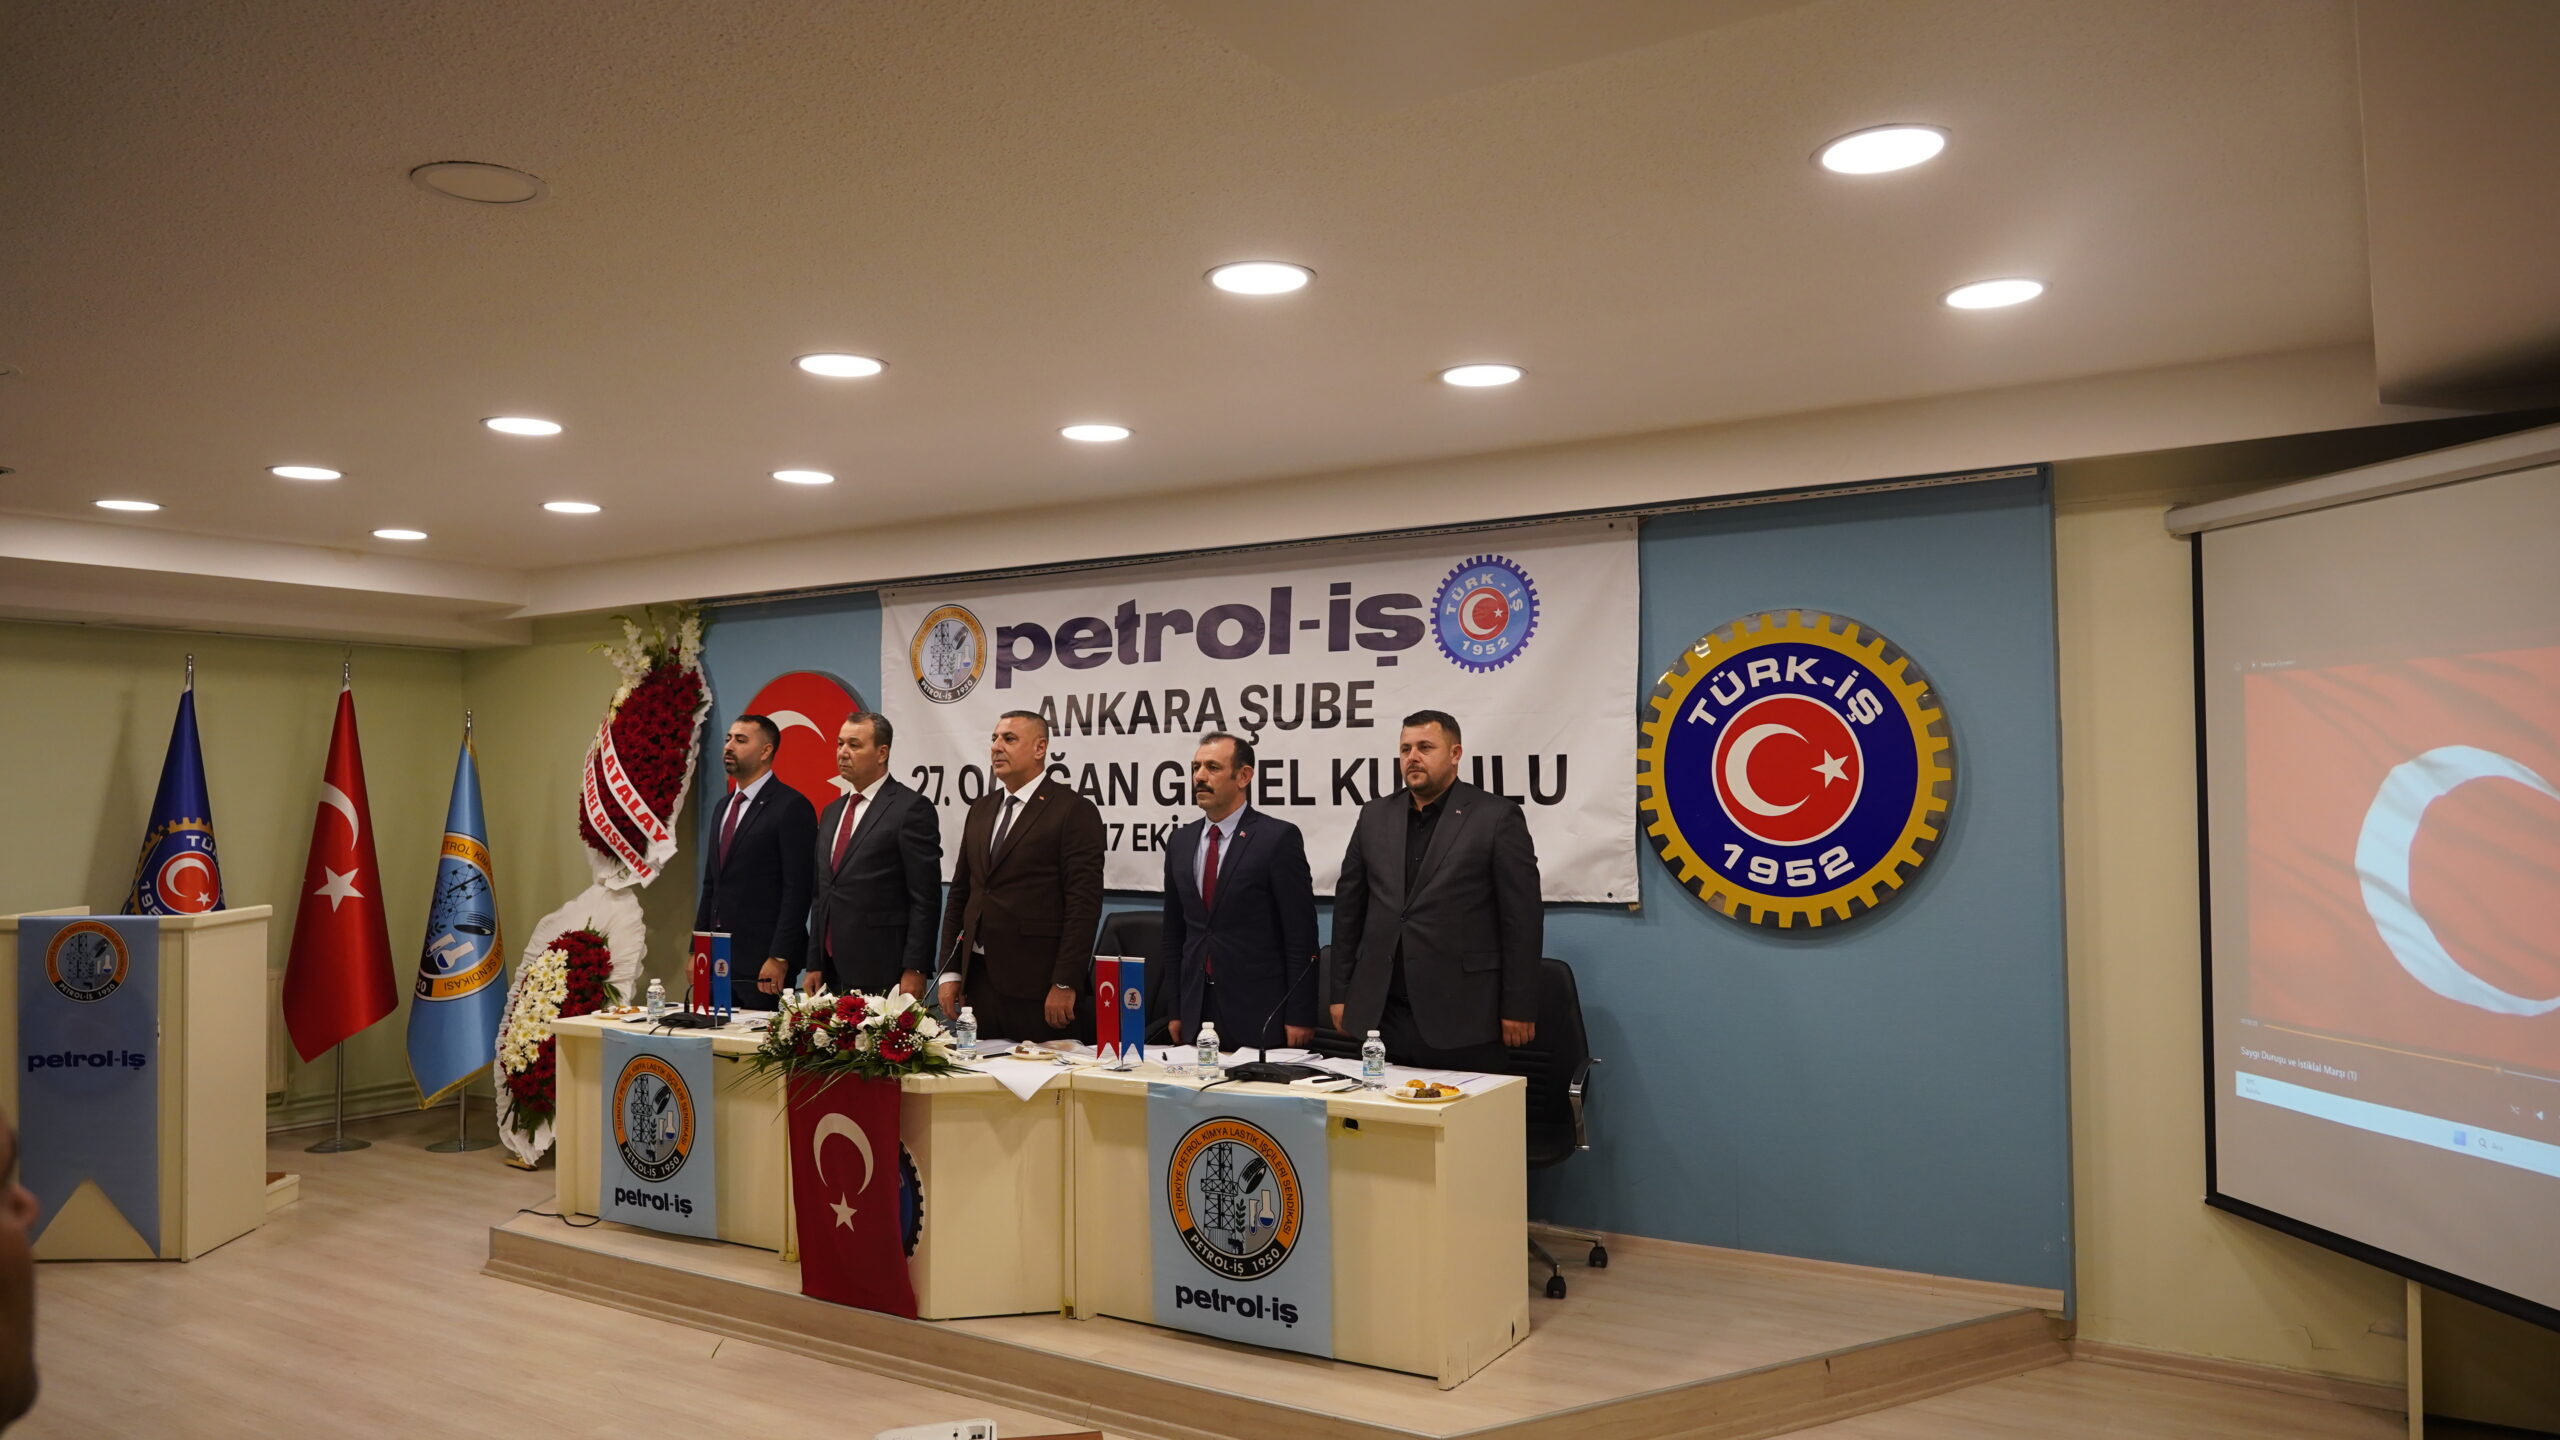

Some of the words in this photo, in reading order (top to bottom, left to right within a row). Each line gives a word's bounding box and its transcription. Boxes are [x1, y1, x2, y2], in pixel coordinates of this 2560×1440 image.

[995, 582, 1426, 690] petrol-iş
[1462, 636, 1509, 656] 1952
[956, 680, 974, 697] 1950
[1687, 655, 1884, 726] TÜRK-İŞ
[1036, 687, 1228, 737] ANKARA
[1238, 680, 1375, 746] ŞUBE
[604, 754, 670, 843] ATALAY
[911, 764, 951, 807] 27.
[958, 752, 1139, 807] OĞAN
[1152, 759, 1316, 807] GEL
[1331, 754, 1568, 807] KULU
[186, 835, 217, 857] TÜ
[442, 840, 471, 856] TROL
[593, 811, 652, 879] BAŞKANI
[1132, 814, 1190, 852] EK
[1723, 843, 1855, 888] 1952
[140, 881, 163, 915] 195
[28, 1050, 146, 1072] petrol-iş
[624, 1147, 657, 1178] PETROL-İŞ
[661, 1156, 680, 1175] 1950
[1178, 1139, 1203, 1169] PETROL
[1201, 1127, 1228, 1141] KİMYA
[615, 1186, 693, 1218] petrol-iş
[1190, 1234, 1244, 1276] PETROL-İŞ
[1251, 1247, 1280, 1273] 1950
[1175, 1285, 1299, 1329] petrol-iş
